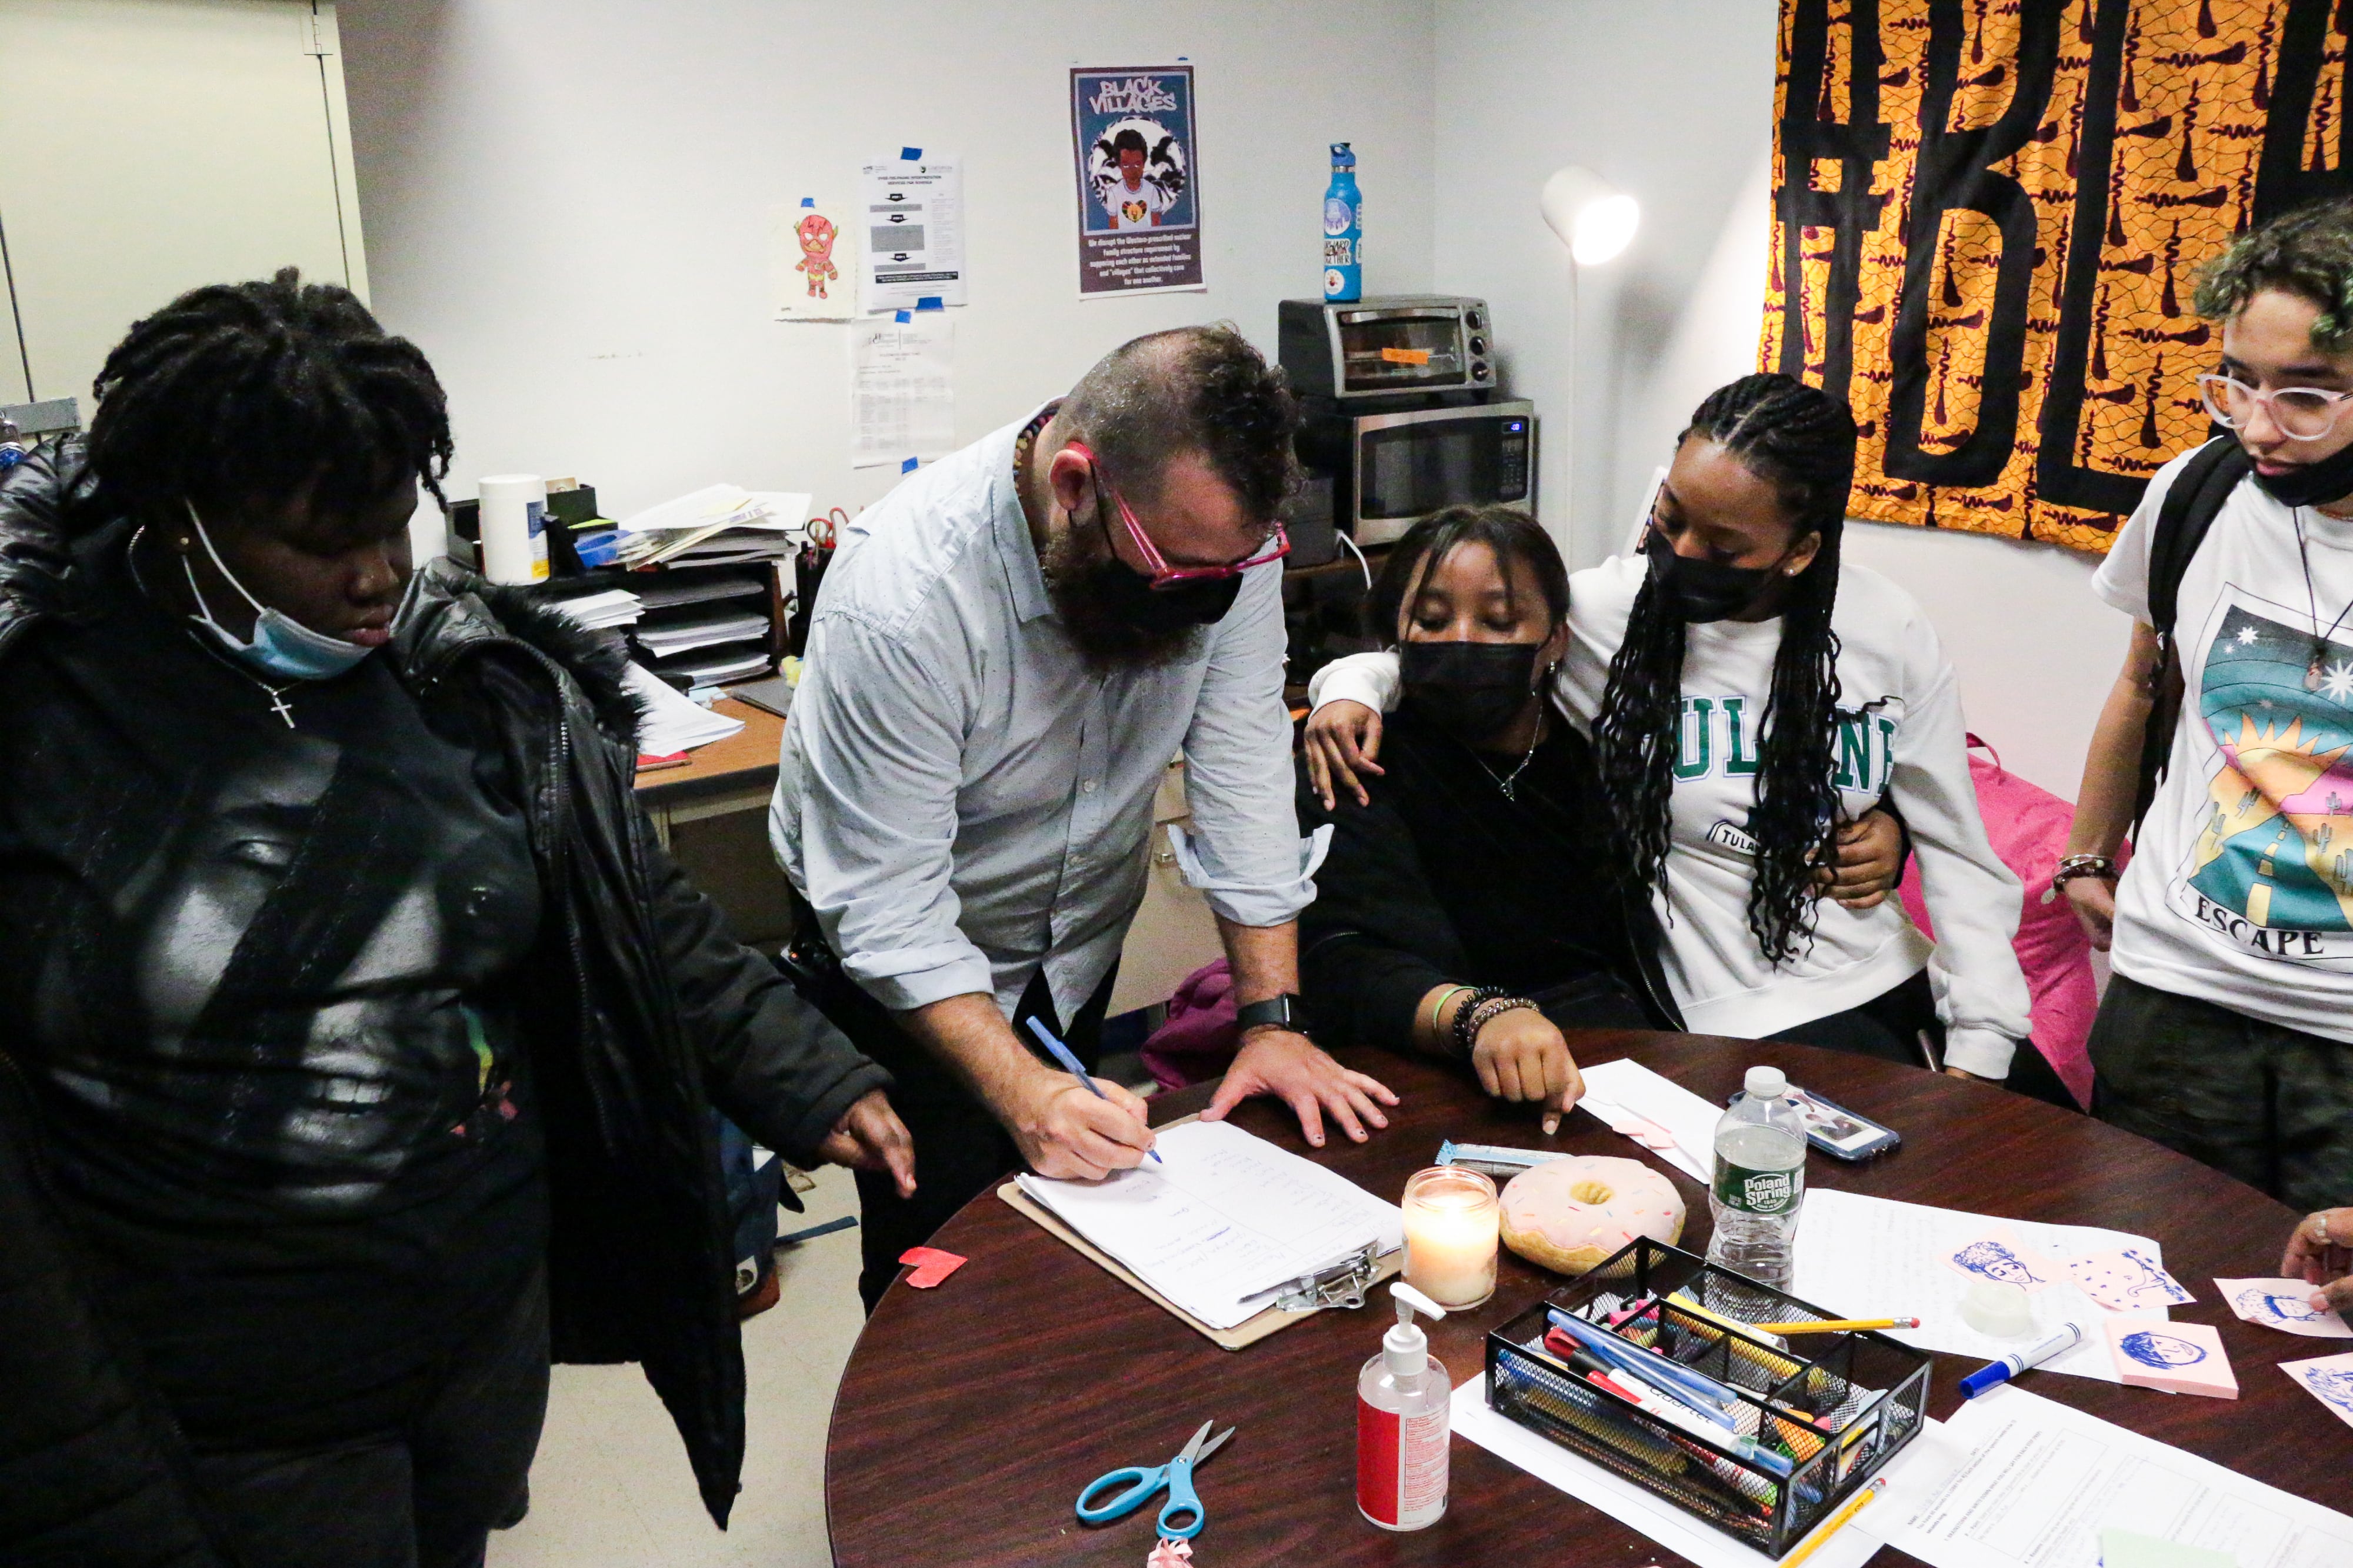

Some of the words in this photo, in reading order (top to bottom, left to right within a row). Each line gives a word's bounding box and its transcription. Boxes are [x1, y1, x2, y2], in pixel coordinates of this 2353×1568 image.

[1100, 75, 1165, 98] BLACK
[1089, 92, 1177, 115] VILLAGES
[1672, 695, 1898, 798] ULNE
[1722, 829, 1755, 852] TULA
[2195, 895, 2325, 956] ESCAPE
[1744, 1173, 1791, 1193] Poland
[1745, 1186, 1791, 1206] Spring
